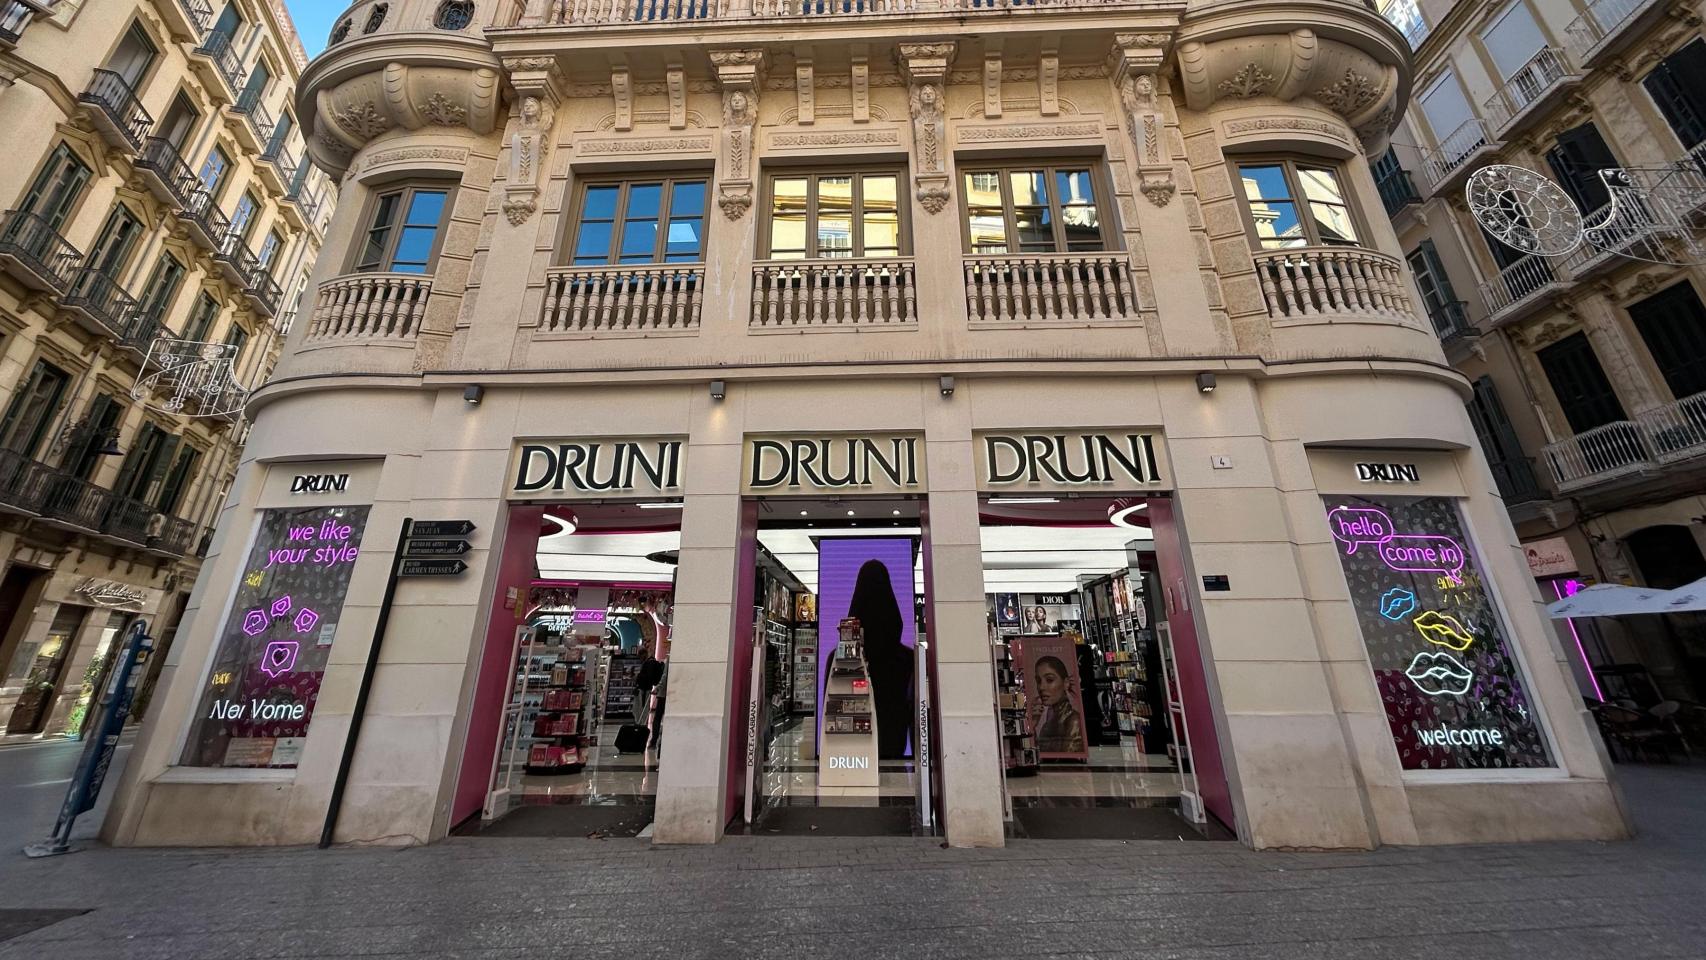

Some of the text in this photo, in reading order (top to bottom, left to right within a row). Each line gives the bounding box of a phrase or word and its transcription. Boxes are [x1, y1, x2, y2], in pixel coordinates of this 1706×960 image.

[514, 442, 682, 490] DRUNI
[750, 438, 918, 486] DRUNI
[985, 435, 1162, 483] DRUNI
[1219, 457, 1225, 466] 4
[290, 473, 349, 493] DRUNI
[1356, 463, 1419, 482] DRUNI
[289, 519, 351, 540] we like
[1338, 515, 1383, 536] hello
[264, 541, 357, 568] your style
[1385, 543, 1457, 563] come in
[1042, 595, 1064, 604] DIOR
[748, 700, 756, 738] GABBANA
[1418, 722, 1503, 746] welcome
[829, 757, 868, 769] DRUNI
